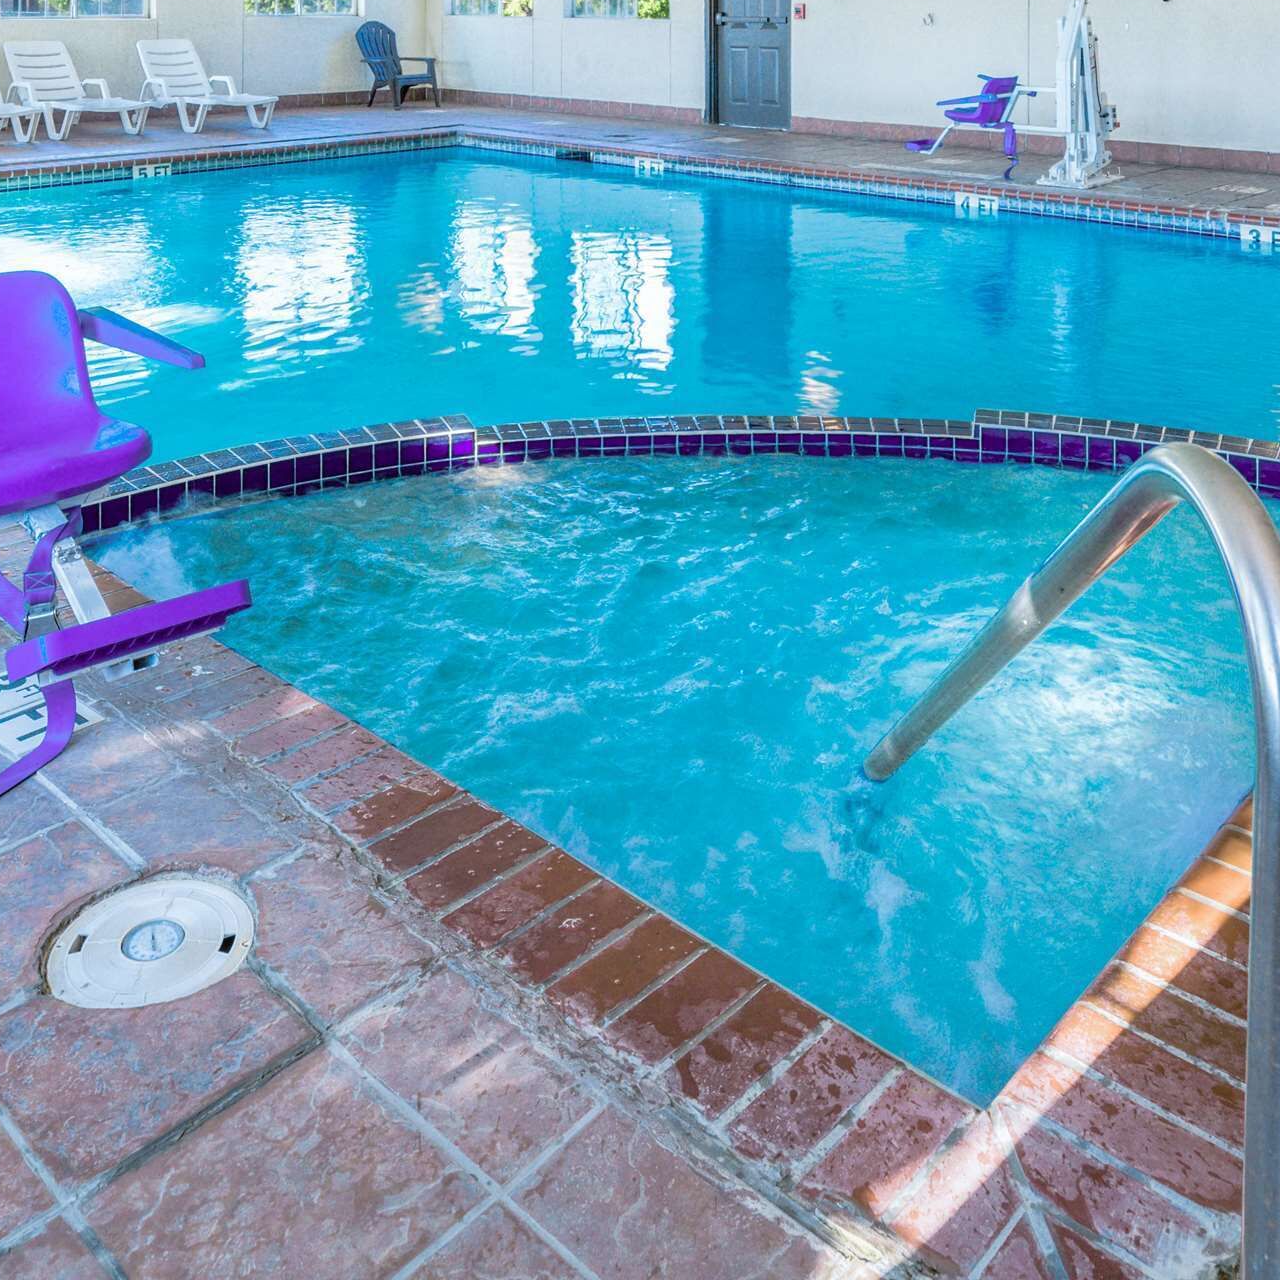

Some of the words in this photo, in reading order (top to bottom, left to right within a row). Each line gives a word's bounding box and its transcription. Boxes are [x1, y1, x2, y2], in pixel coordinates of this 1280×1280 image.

[139, 167, 148, 179] 5
[154, 165, 170, 177] FT
[1249, 229, 1261, 243] 3
